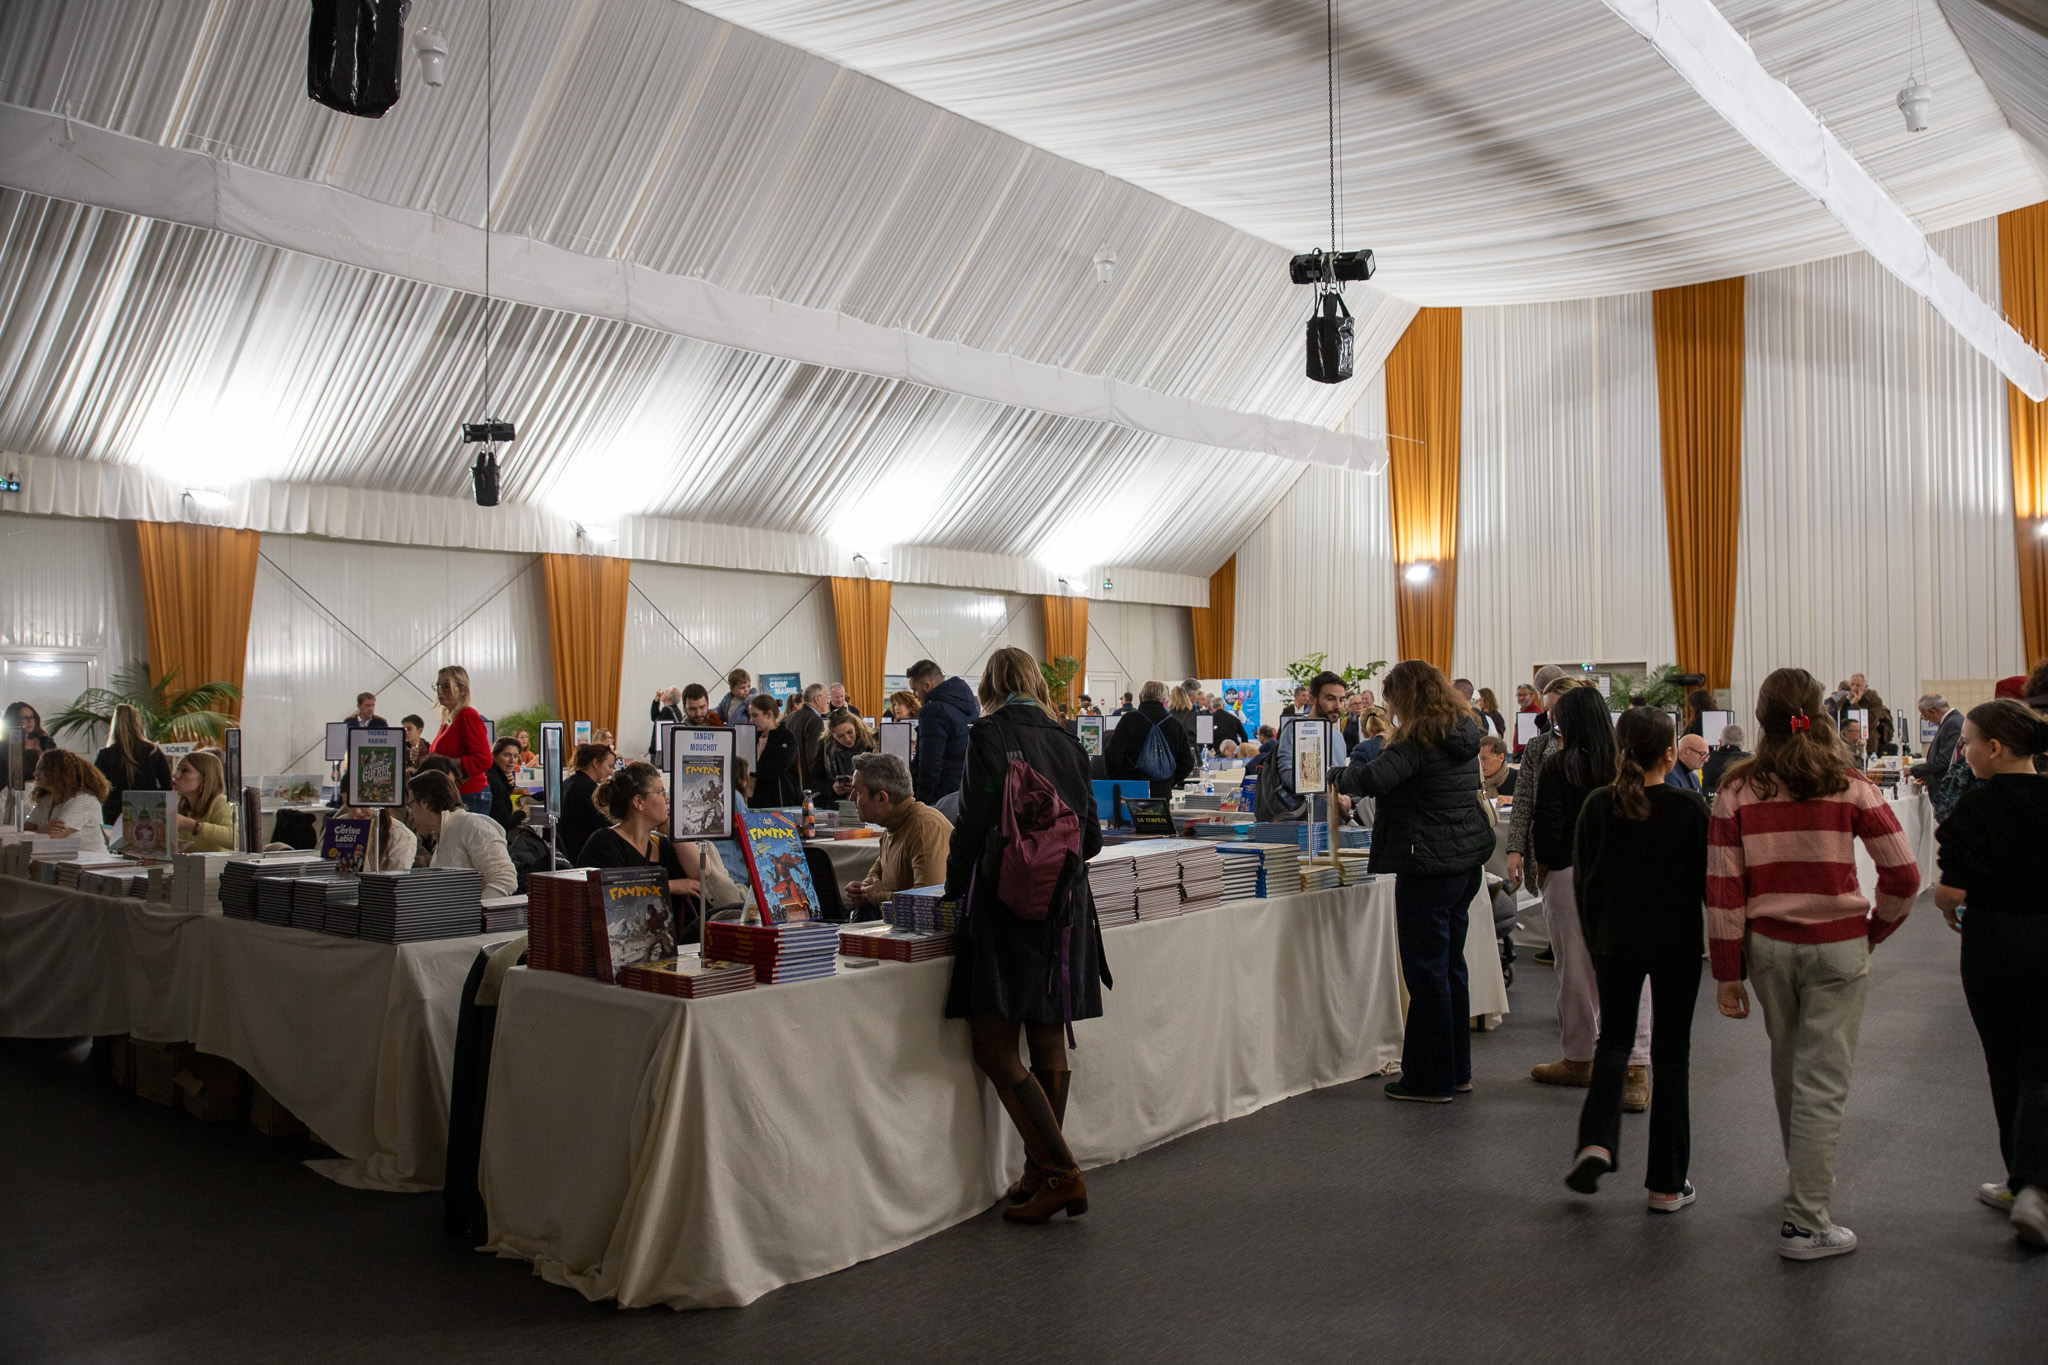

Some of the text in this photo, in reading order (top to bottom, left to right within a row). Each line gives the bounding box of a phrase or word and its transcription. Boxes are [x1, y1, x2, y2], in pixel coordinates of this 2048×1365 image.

[694, 732, 714, 740] TANGUY
[362, 763, 391, 782] GUERRE
[685, 766, 720, 776] FANTAX
[334, 826, 361, 834] Cerise
[749, 827, 796, 840] FANTAX
[609, 885, 662, 900] FANTAX
